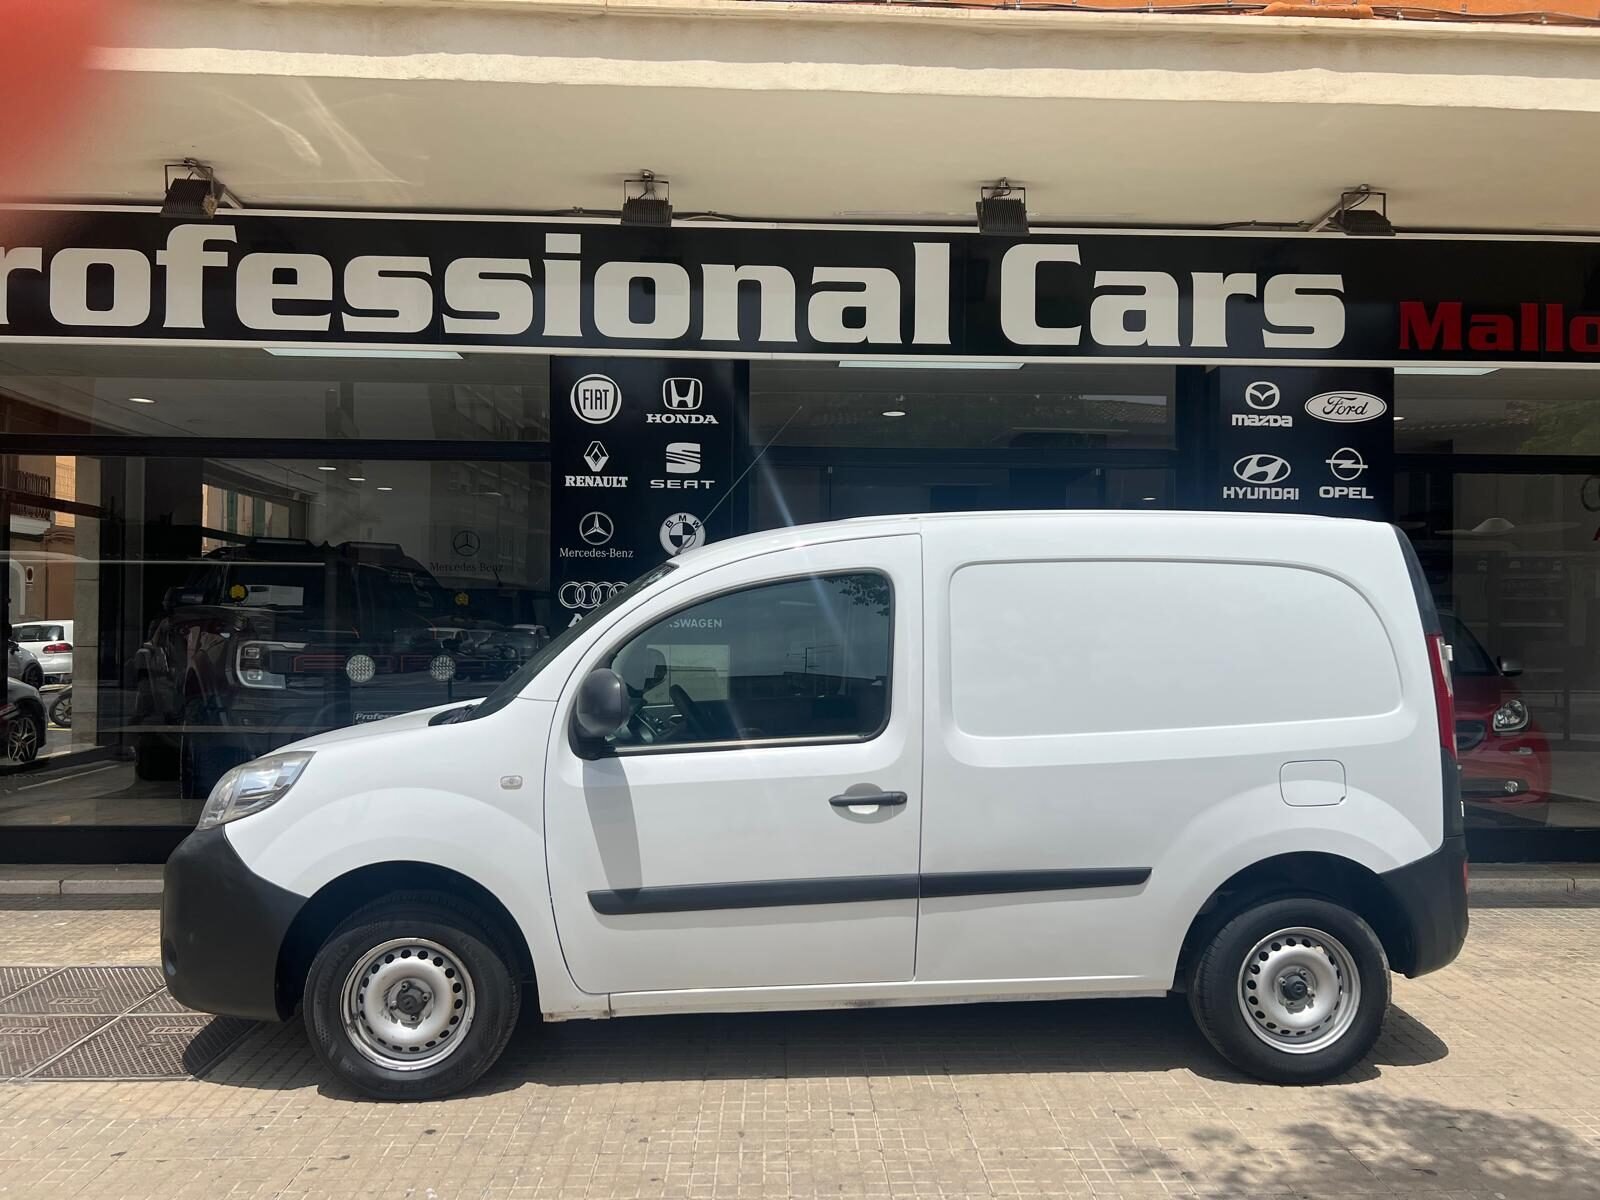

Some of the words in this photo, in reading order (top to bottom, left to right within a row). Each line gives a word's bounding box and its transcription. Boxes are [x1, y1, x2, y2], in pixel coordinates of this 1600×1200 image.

[1000, 243, 1346, 350] Cars
[1399, 301, 1600, 353] Mallo
[582, 388, 610, 411] FIAT
[1322, 395, 1368, 416] Ford
[646, 413, 719, 424] HONDA
[564, 475, 628, 488] RENAULT
[650, 479, 716, 489] SEAT
[1223, 486, 1299, 501] HYUNDAI
[1319, 486, 1375, 500] OPEL
[665, 514, 702, 530] BMW
[559, 547, 634, 559] Mercedes-Benz
[666, 618, 723, 629] SWAGEN
